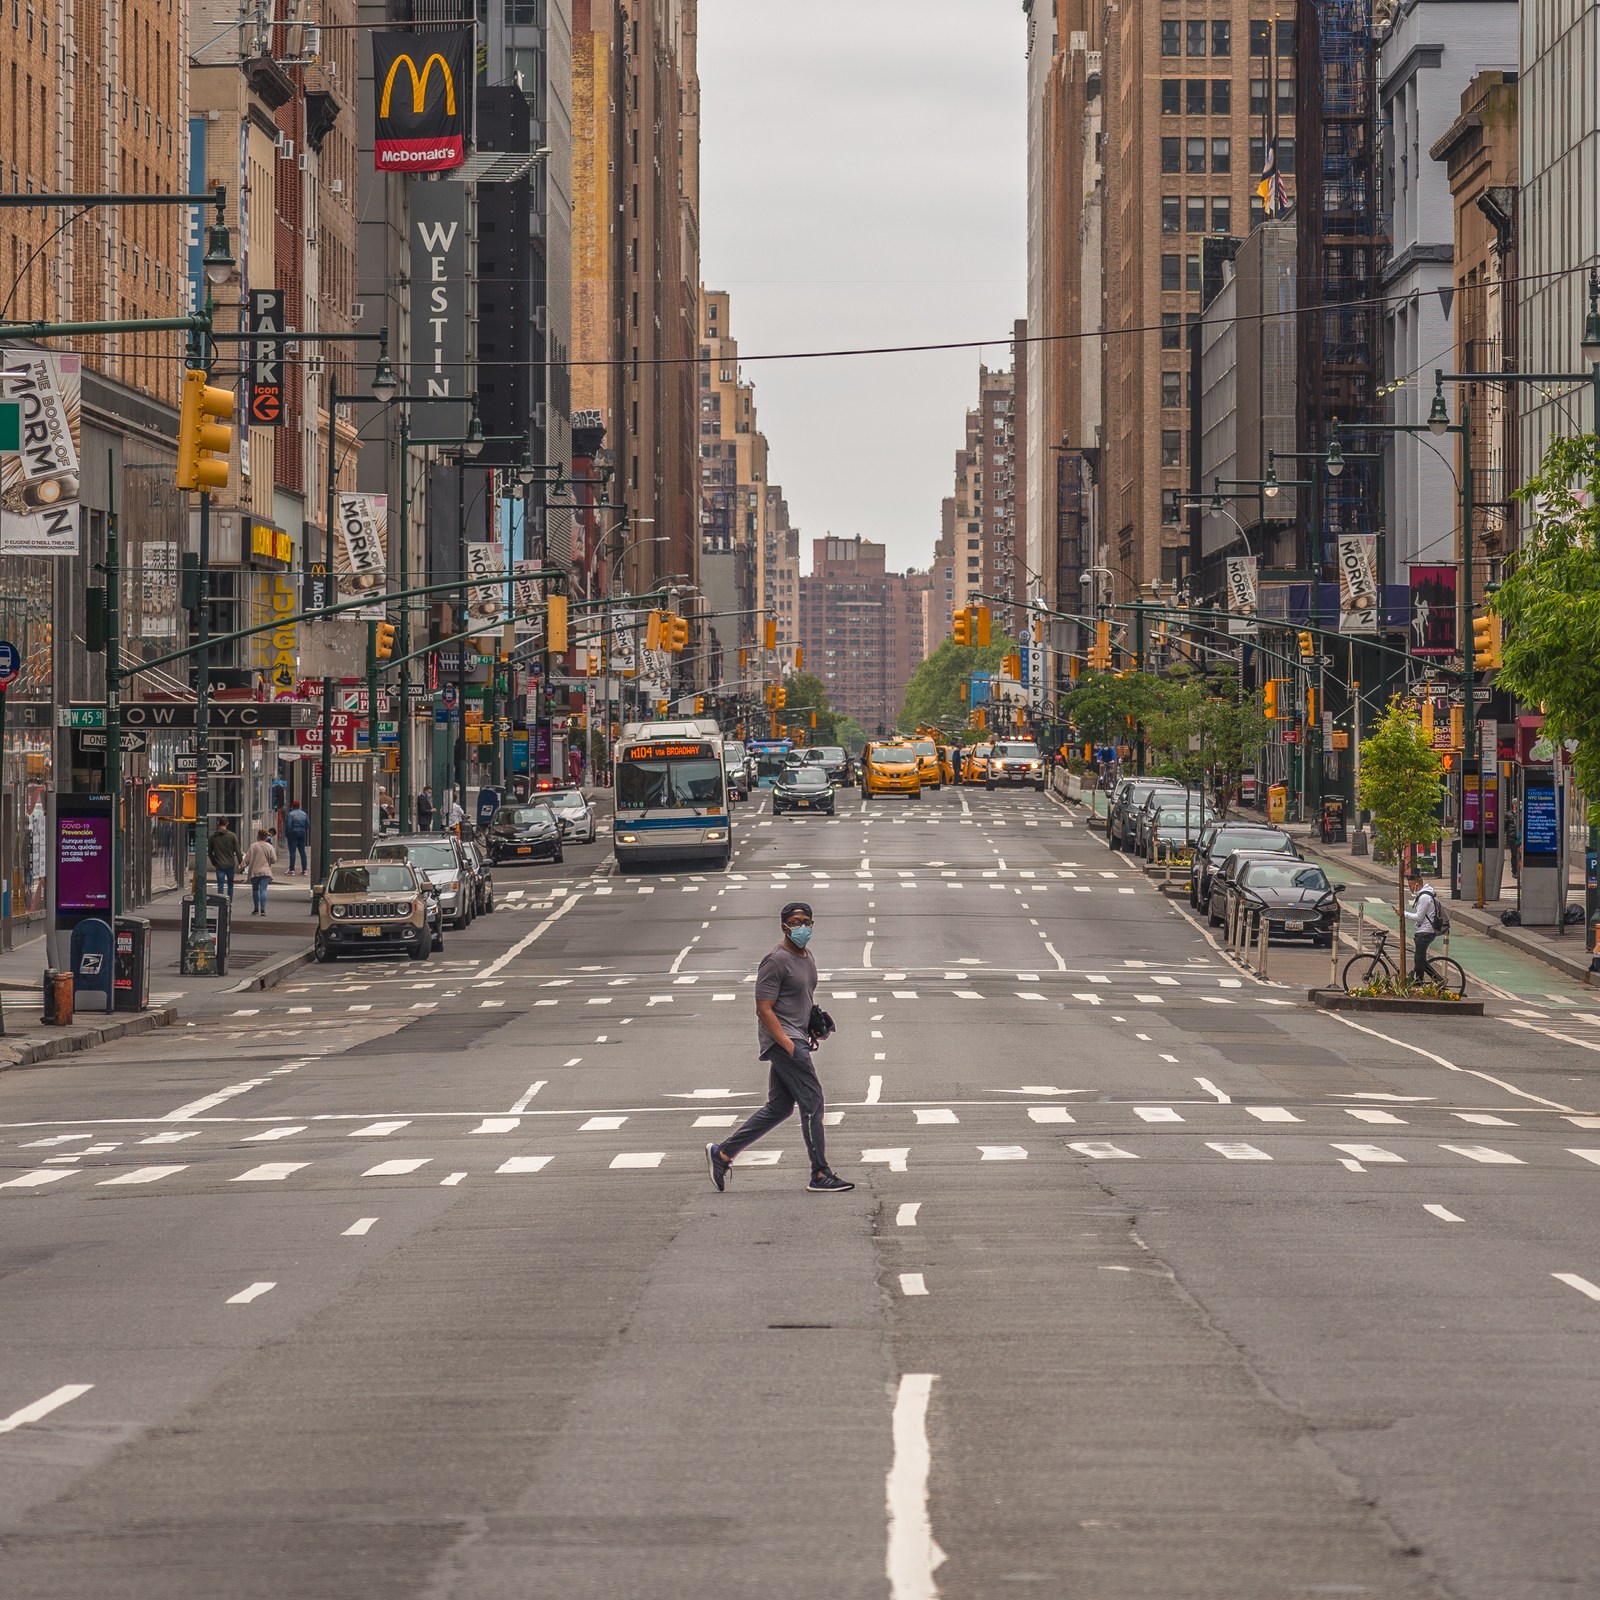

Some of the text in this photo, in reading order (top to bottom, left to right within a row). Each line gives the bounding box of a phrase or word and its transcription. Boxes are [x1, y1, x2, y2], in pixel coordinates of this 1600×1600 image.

[381, 148, 455, 163] McDonald's
[417, 221, 458, 404] WESTIN
[257, 294, 278, 383] PARK
[254, 385, 279, 394] icon
[34, 359, 71, 466] THE BOOK OF
[71, 711, 79, 723] W
[82, 711, 94, 724] 45
[89, 735, 139, 747] ONE WAY
[631, 747, 653, 759] M104
[666, 746, 699, 755] BROADWAY
[182, 759, 224, 767] ONE WAY
[78, 843, 102, 851] quédese
[117, 937, 133, 945] ERIKA
